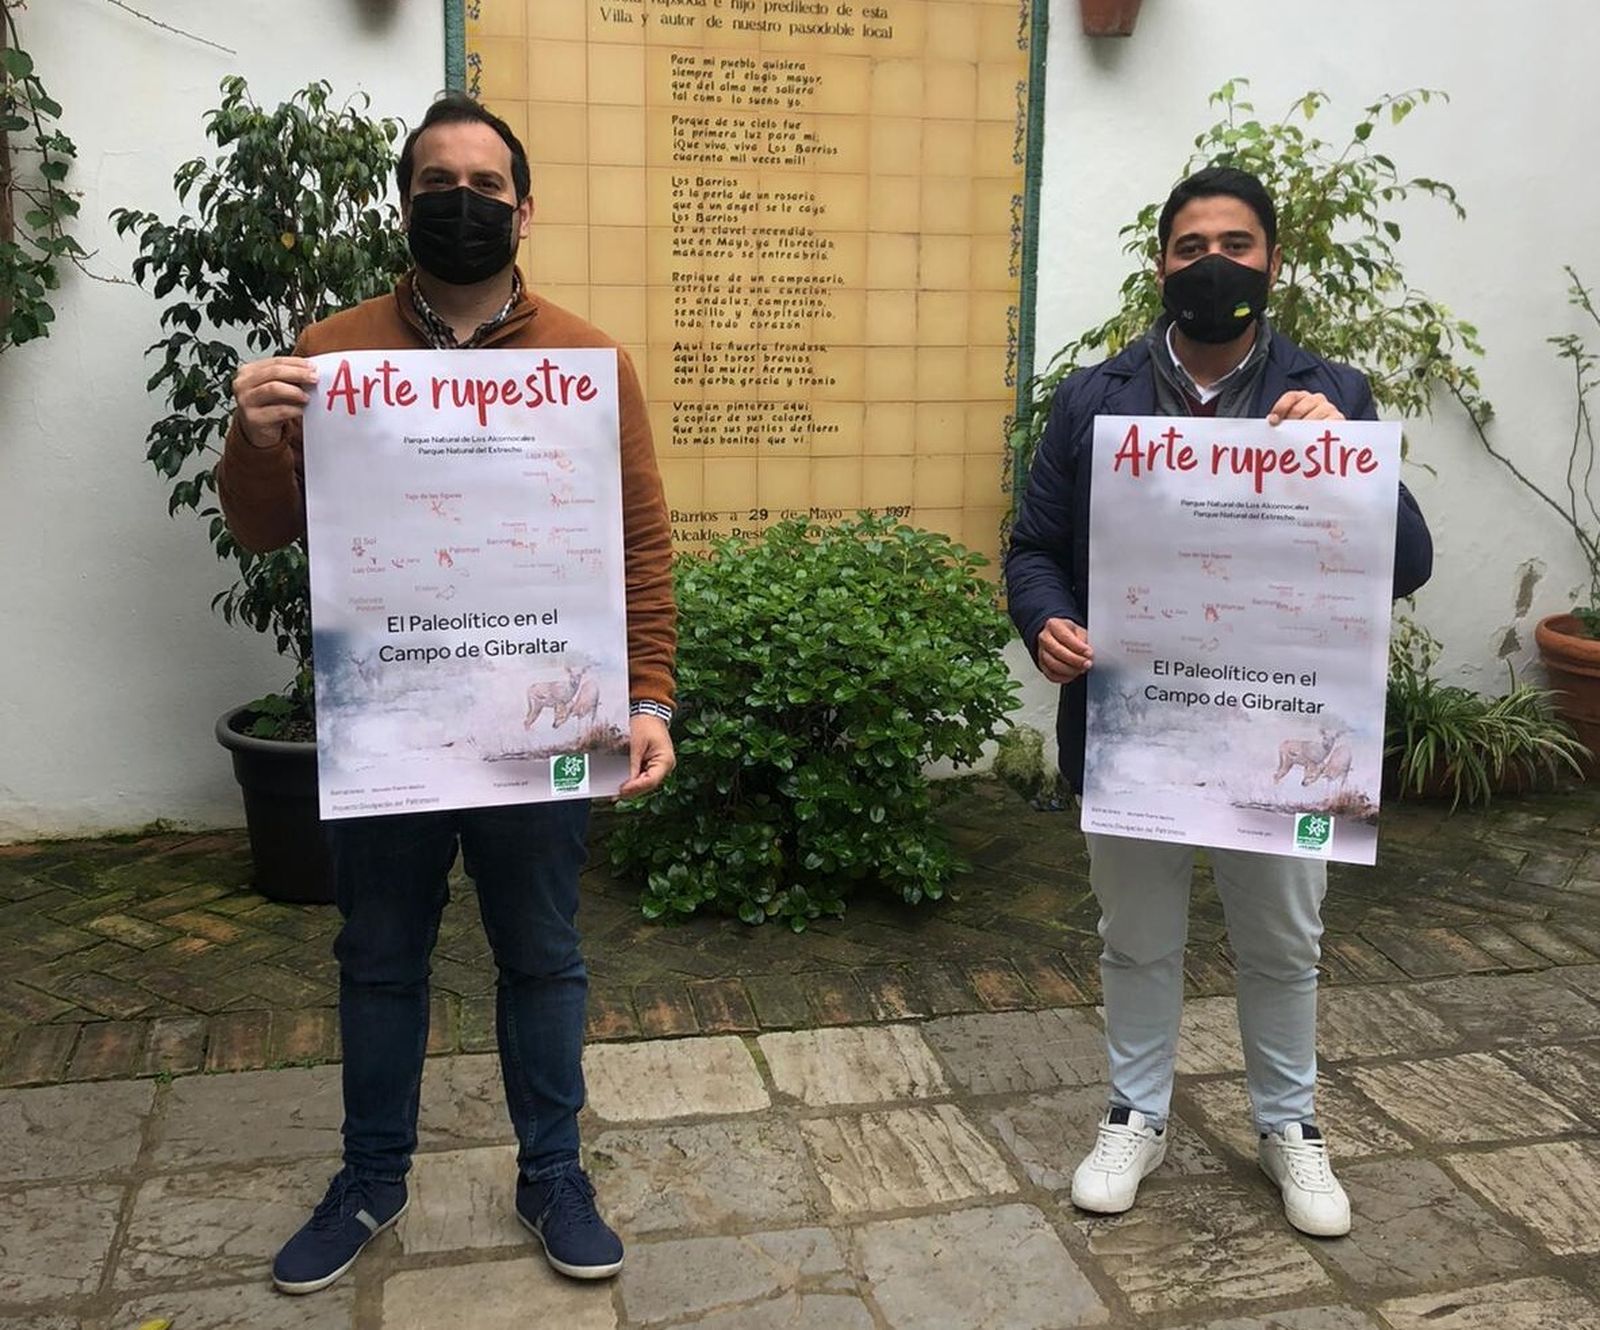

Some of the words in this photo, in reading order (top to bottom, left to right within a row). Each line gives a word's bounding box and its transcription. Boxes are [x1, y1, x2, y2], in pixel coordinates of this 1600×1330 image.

[836, 3, 853, 17] de
[862, 6, 888, 19] esta
[599, 6, 633, 23] Villa
[641, 13, 650, 28] y
[660, 12, 696, 27] autor
[706, 14, 723, 28] de
[732, 18, 782, 33] nuestro
[789, 21, 855, 37] pasodoble
[862, 23, 893, 39] local
[671, 54, 695, 65] Para
[703, 57, 715, 66] mi
[721, 58, 755, 69] pueblo
[762, 59, 805, 71] quisiera
[672, 67, 713, 79] siempre
[725, 69, 735, 79] el
[744, 70, 777, 83] elogio
[672, 80, 691, 90] que
[697, 81, 714, 90] del
[720, 81, 746, 92] alma
[752, 85, 767, 93] me
[776, 84, 814, 95] saliera
[672, 92, 687, 101] tal
[693, 93, 722, 103] como
[732, 94, 742, 103] lo
[672, 115, 709, 127] Porque
[715, 117, 727, 126] de
[734, 119, 745, 127] su
[751, 118, 777, 128] cielo
[783, 119, 800, 129] fue
[673, 127, 684, 136] la
[692, 129, 737, 139] primera
[745, 129, 761, 139] luz
[768, 131, 795, 141] para
[768, 143, 786, 154] Los
[795, 144, 838, 155] Barrios
[673, 153, 723, 162] cuarenta
[730, 154, 746, 163] mil
[752, 156, 781, 164] veces
[672, 176, 689, 188] Los
[696, 177, 738, 187] Barrios
[672, 189, 683, 197] es
[689, 188, 699, 197] la
[703, 189, 733, 199] perla
[740, 191, 751, 199] de
[757, 192, 769, 200] un
[673, 202, 691, 211] que
[766, 204, 776, 212] se
[782, 203, 792, 212] le
[672, 212, 689, 224] Los
[696, 214, 738, 223] Barrios
[692, 227, 705, 235] un
[712, 226, 746, 235] clavel
[673, 237, 693, 247] que
[742, 251, 754, 259] se
[672, 272, 720, 285] Repique
[728, 273, 742, 282] de
[675, 284, 720, 293] estrofa
[728, 285, 742, 294] de
[675, 308, 724, 316] sencillo
[735, 310, 741, 319] y
[711, 319, 738, 328] todo
[711, 342, 722, 350] la
[728, 341, 767, 351] huerta
[703, 353, 718, 362] los
[725, 354, 755, 362] toros
[705, 364, 714, 373] la
[674, 377, 693, 385] con
[740, 376, 779, 388] gracia
[787, 377, 792, 387] y
[327, 359, 418, 415] Arte
[431, 358, 598, 427] rupestre
[673, 402, 719, 413] Vengan
[727, 403, 775, 412] pintores
[684, 412, 722, 423] copiar
[727, 414, 740, 422] de
[673, 425, 692, 434] que
[746, 424, 783, 434] patios
[790, 424, 802, 432] de
[807, 424, 838, 432] flores
[673, 436, 688, 445] los
[720, 436, 760, 445] bonitos
[768, 436, 786, 445] que
[418, 447, 444, 456] Parque
[1114, 423, 1198, 477] Arte
[1211, 430, 1378, 494] rupestre
[1180, 500, 1206, 508] Parque
[1207, 501, 1234, 509] Natural
[1246, 501, 1260, 509] Los
[670, 509, 719, 523] Barrios
[729, 511, 738, 521] a
[748, 508, 769, 521] 29
[780, 508, 798, 520] de
[809, 507, 843, 523] Mayo
[886, 506, 911, 518] 1997
[1194, 511, 1218, 520] Parque
[1219, 511, 1248, 520] Natural
[387, 616, 404, 633] El
[410, 611, 510, 633] Paleolítico
[514, 613, 537, 626] en
[542, 609, 558, 625] el
[379, 645, 451, 664] Campo
[455, 642, 480, 658] de
[484, 638, 568, 657] Gibraltar
[1153, 660, 1169, 675] El
[1174, 661, 1269, 684] Paleolítico
[1273, 672, 1296, 685] en
[1300, 670, 1317, 687] el
[1144, 685, 1210, 705] Campo
[1214, 690, 1237, 707] de
[1242, 693, 1325, 715] Gibraltar
